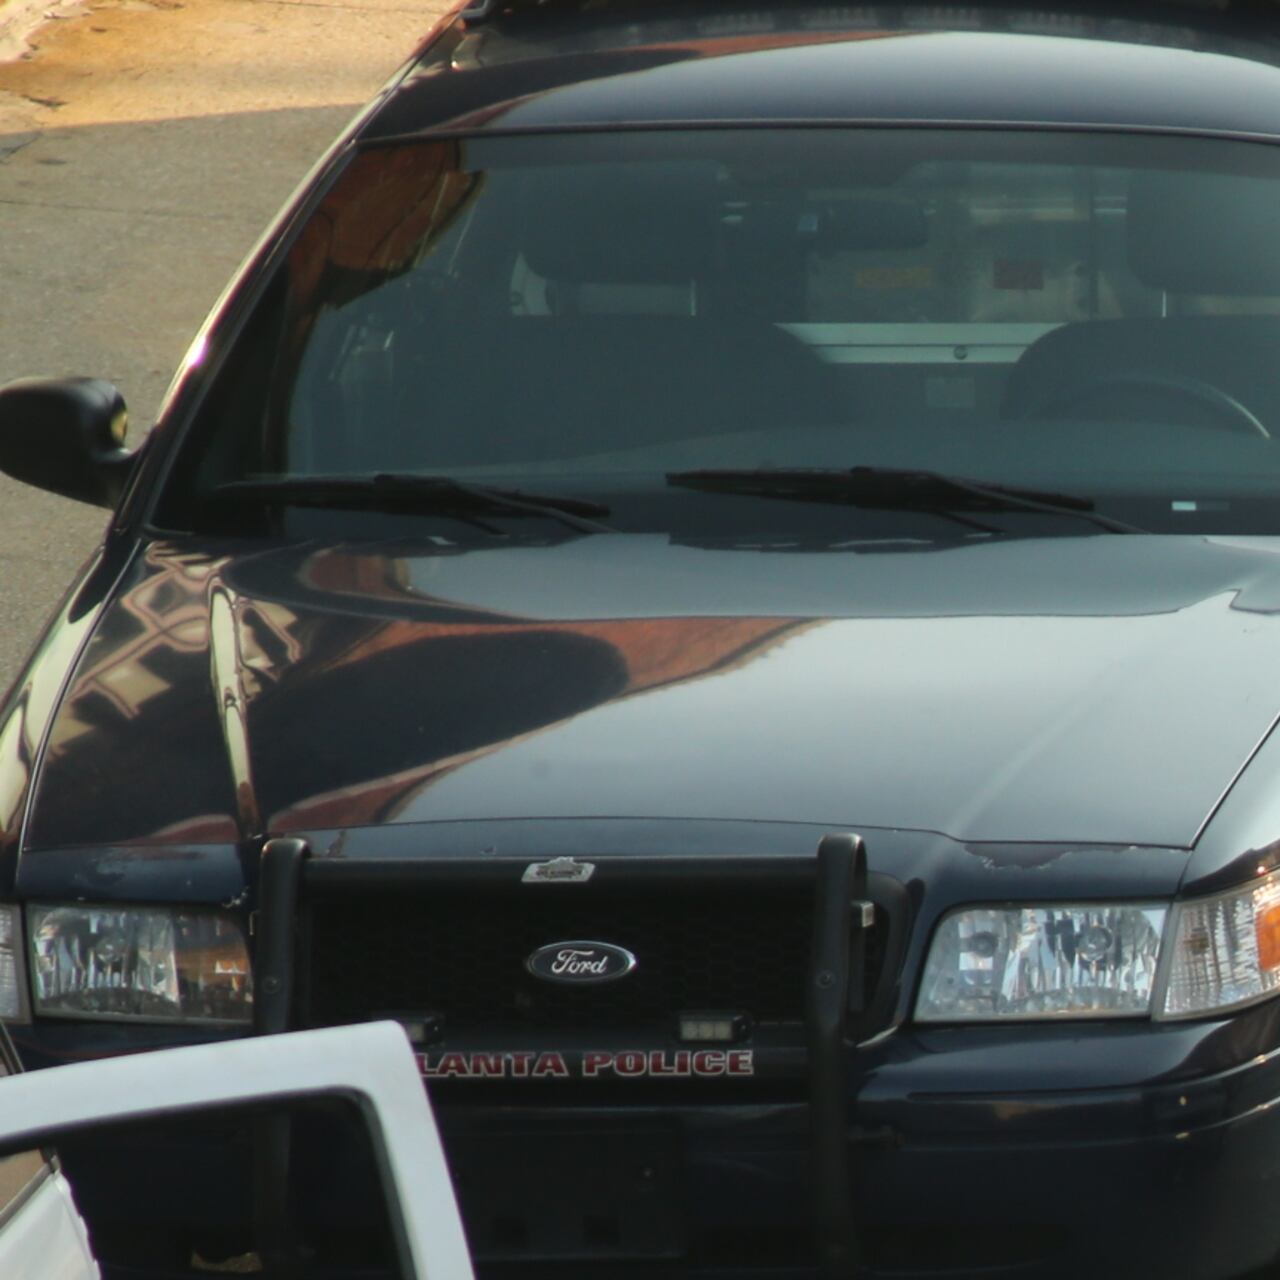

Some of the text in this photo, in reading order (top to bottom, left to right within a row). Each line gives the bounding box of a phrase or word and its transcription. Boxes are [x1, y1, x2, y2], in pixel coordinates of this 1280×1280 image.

[551, 950, 607, 974] Ford
[415, 1050, 754, 1076] LANTA POLICE
